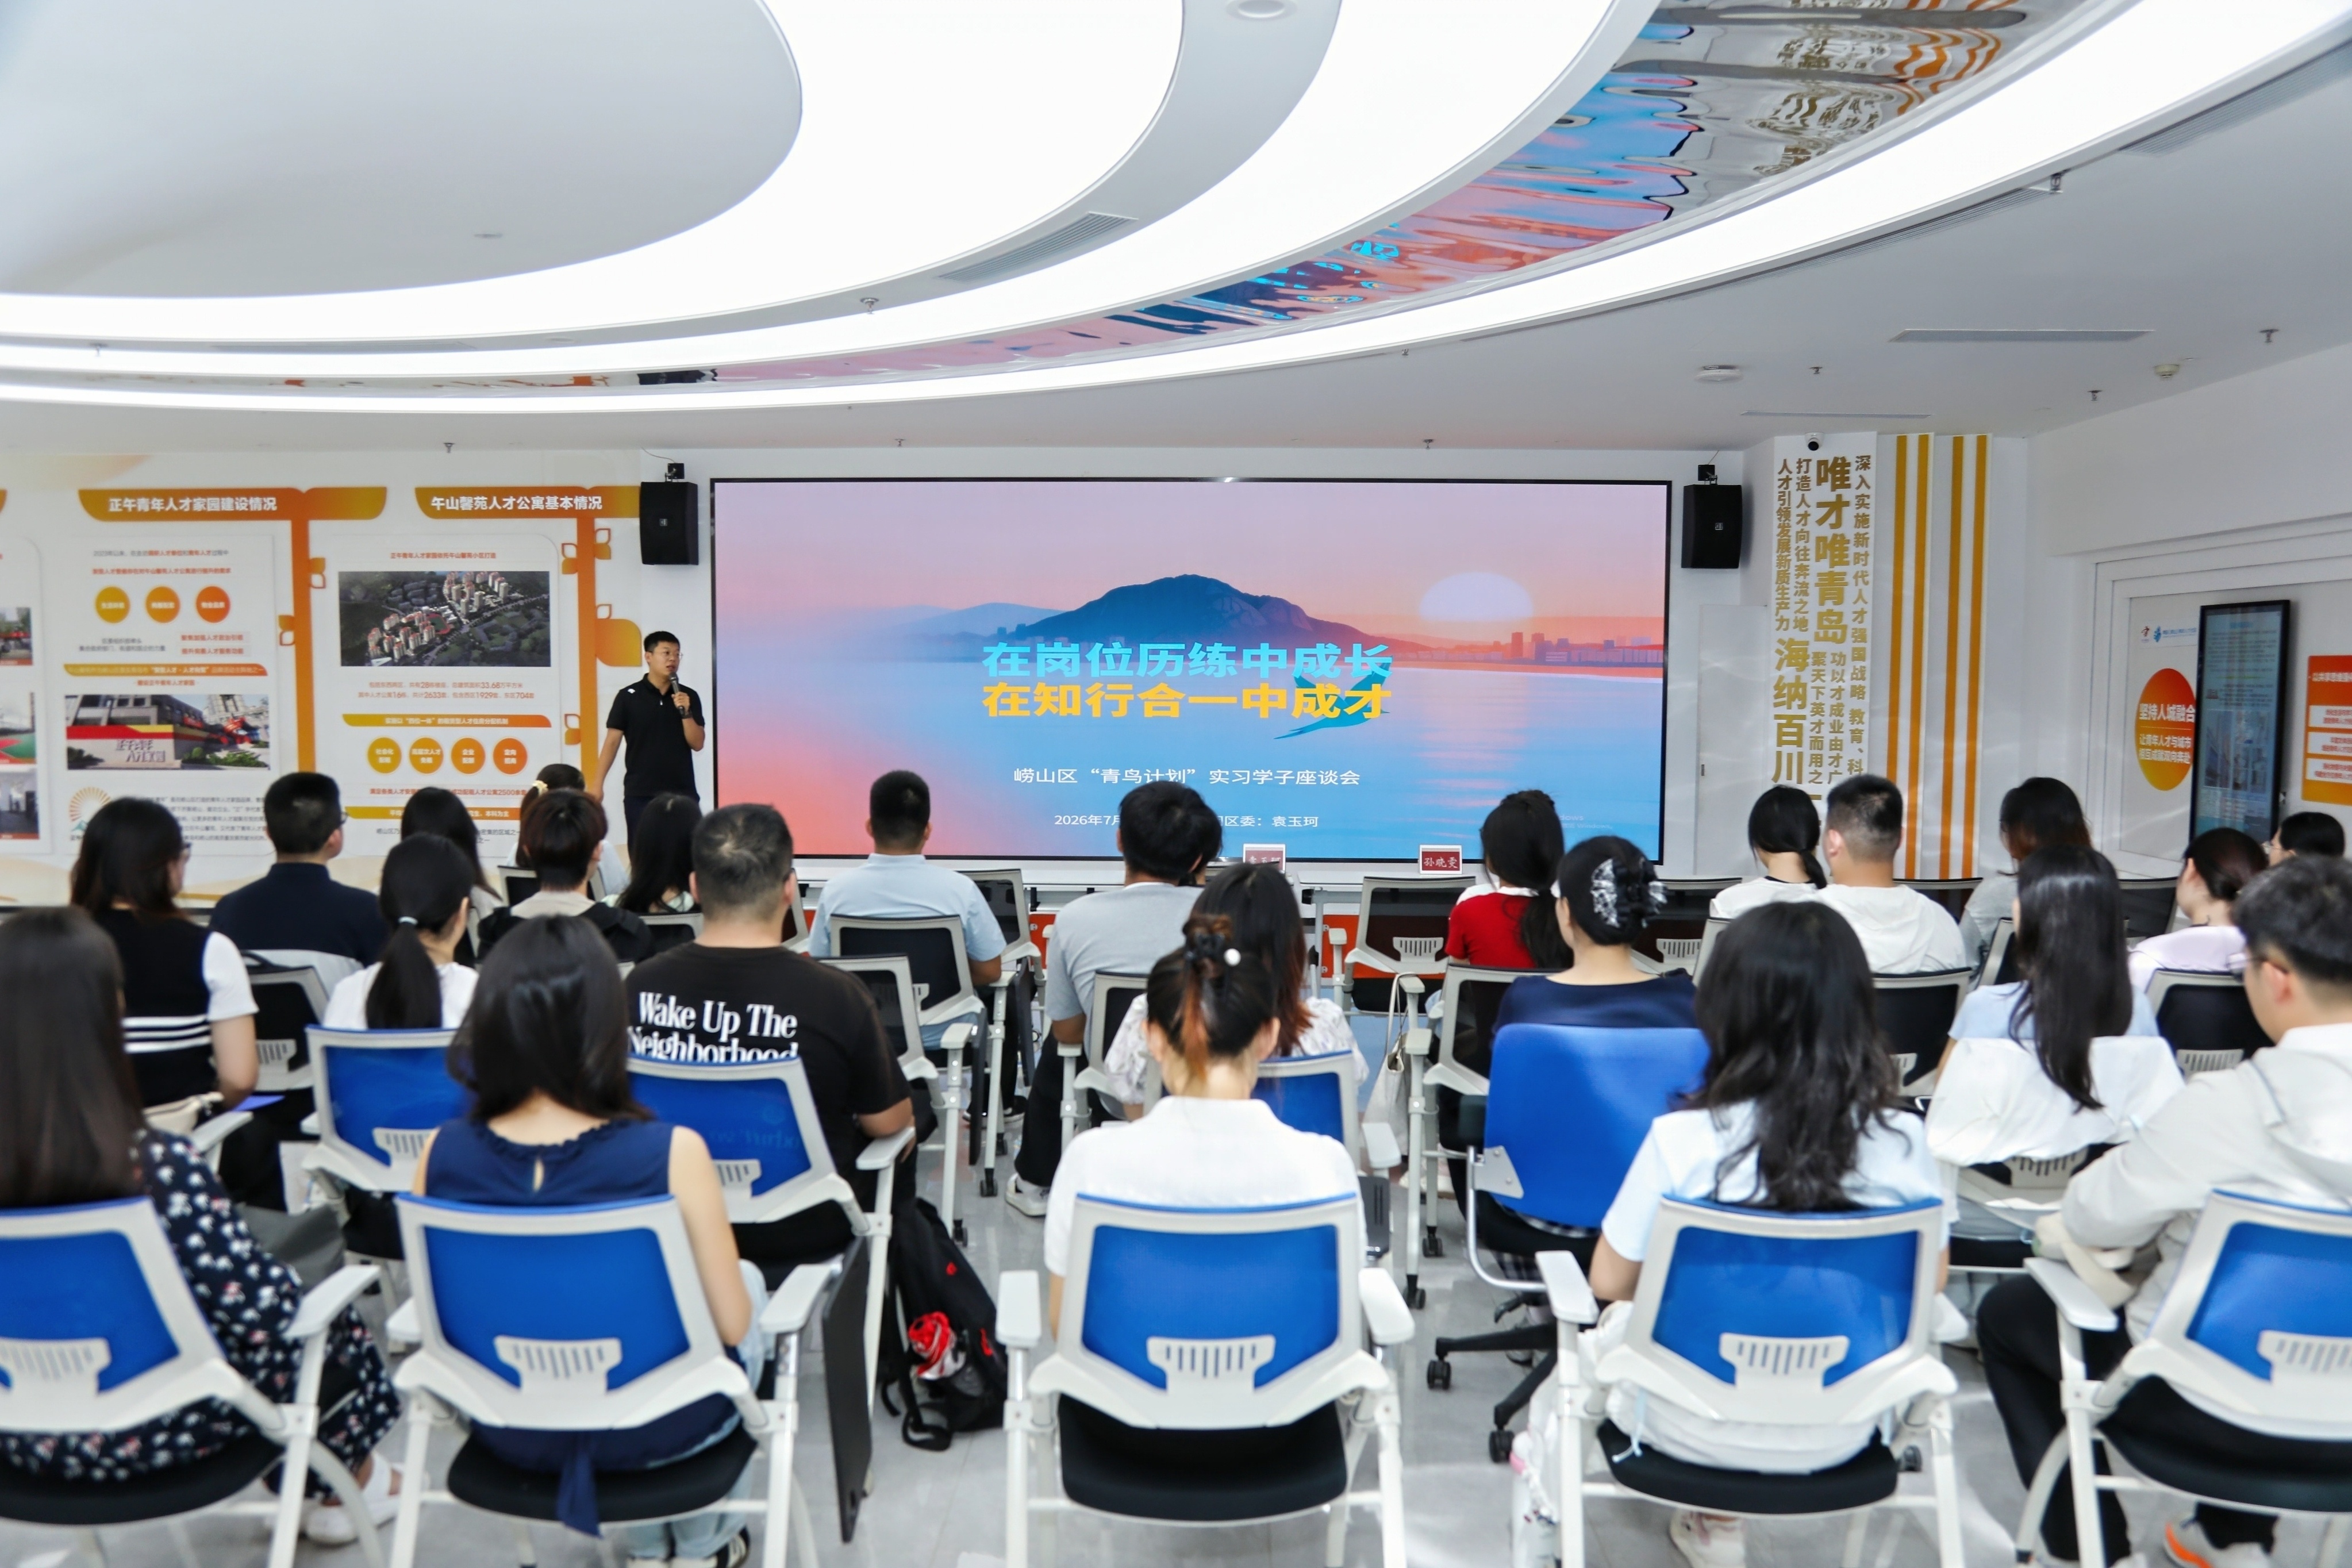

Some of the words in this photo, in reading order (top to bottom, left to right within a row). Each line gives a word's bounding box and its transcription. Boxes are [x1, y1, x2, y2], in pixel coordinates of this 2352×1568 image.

[108, 497, 278, 512] 正午青年人才家园建设情况
[431, 495, 602, 510] 午山馨苑人才公寓基本情况
[1774, 459, 1793, 631] 人才引领发展新质生产力
[1793, 458, 1812, 632] 打造人才向往奔流之地
[1813, 456, 1851, 644] 唯才唯青岛
[982, 641, 1393, 678] 在岗位历练中成长
[982, 682, 1392, 718] 在知行合一中成才
[1771, 637, 1809, 785] 海纳百川
[1808, 651, 1827, 784] 聚天下英才而用之
[1827, 652, 1847, 785] 功以才成业由才广
[639, 991, 697, 1030] Wake
[702, 1000, 741, 1043] Up
[746, 1004, 798, 1039] The
